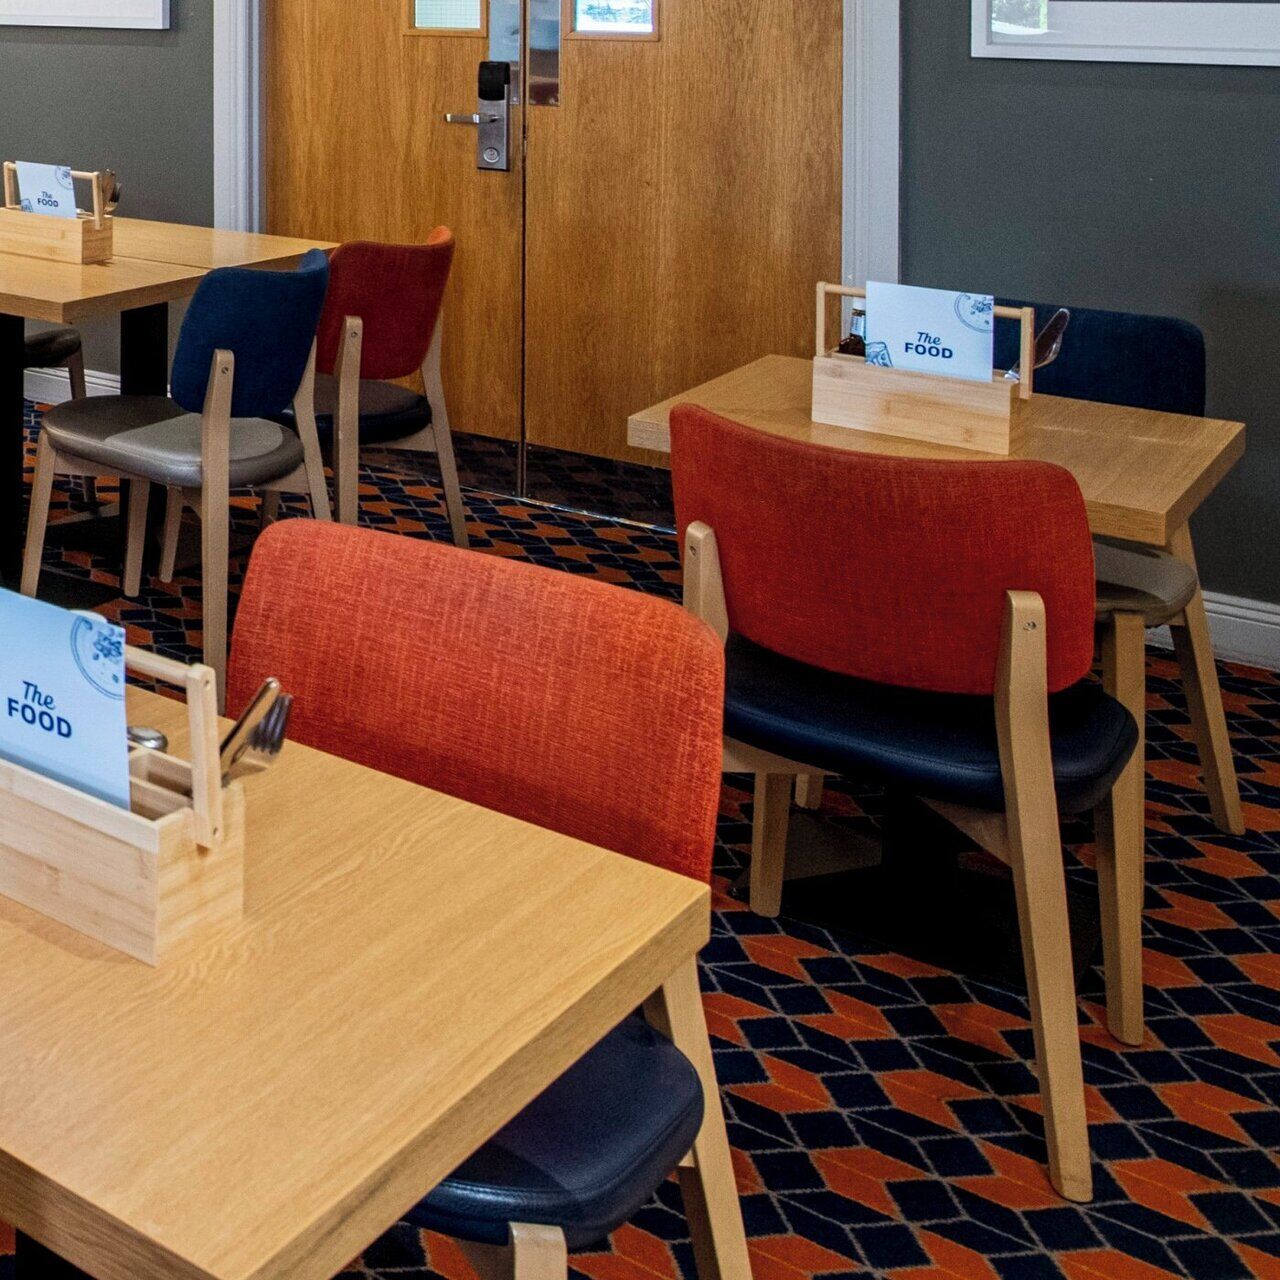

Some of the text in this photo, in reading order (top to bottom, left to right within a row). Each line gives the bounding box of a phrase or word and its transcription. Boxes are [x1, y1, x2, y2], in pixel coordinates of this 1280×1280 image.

[37, 198, 59, 208] FOOD
[916, 331, 942, 345] The
[904, 342, 953, 359] FOOD
[21, 681, 56, 709] The
[7, 697, 73, 739] FOOD
